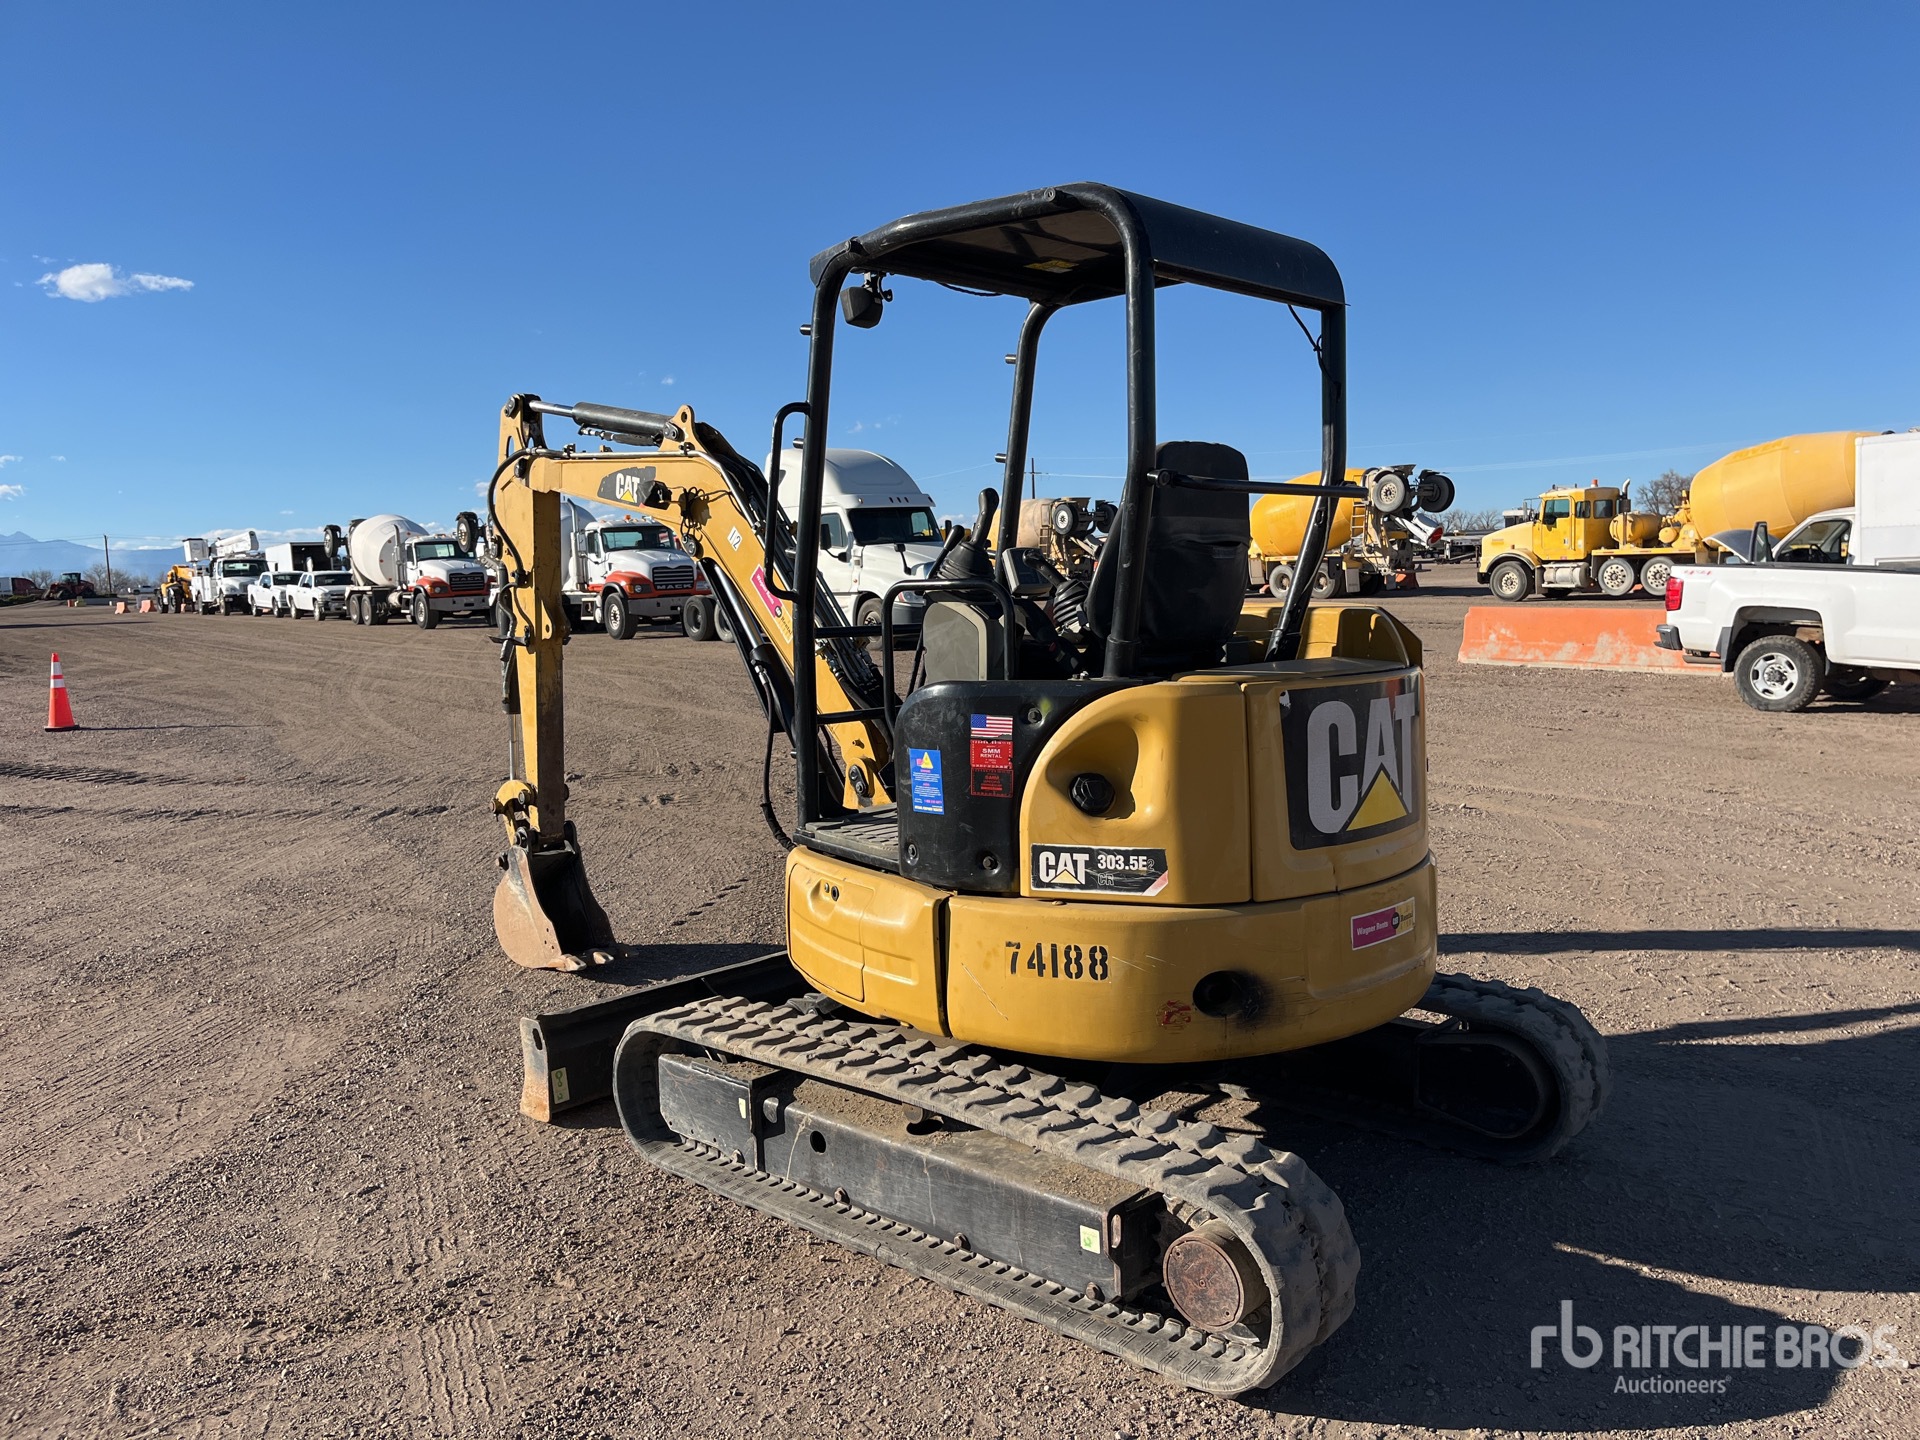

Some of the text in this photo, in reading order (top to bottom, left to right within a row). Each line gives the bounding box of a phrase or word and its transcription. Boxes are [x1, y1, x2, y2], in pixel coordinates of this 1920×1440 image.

[615, 472, 641, 504] CAT
[1307, 692, 1416, 834] CAT
[1039, 851, 1090, 885] CAT
[1097, 873, 1115, 886] CR
[1357, 921, 1389, 935] Wagner Rents
[1005, 941, 1109, 981] 74188
